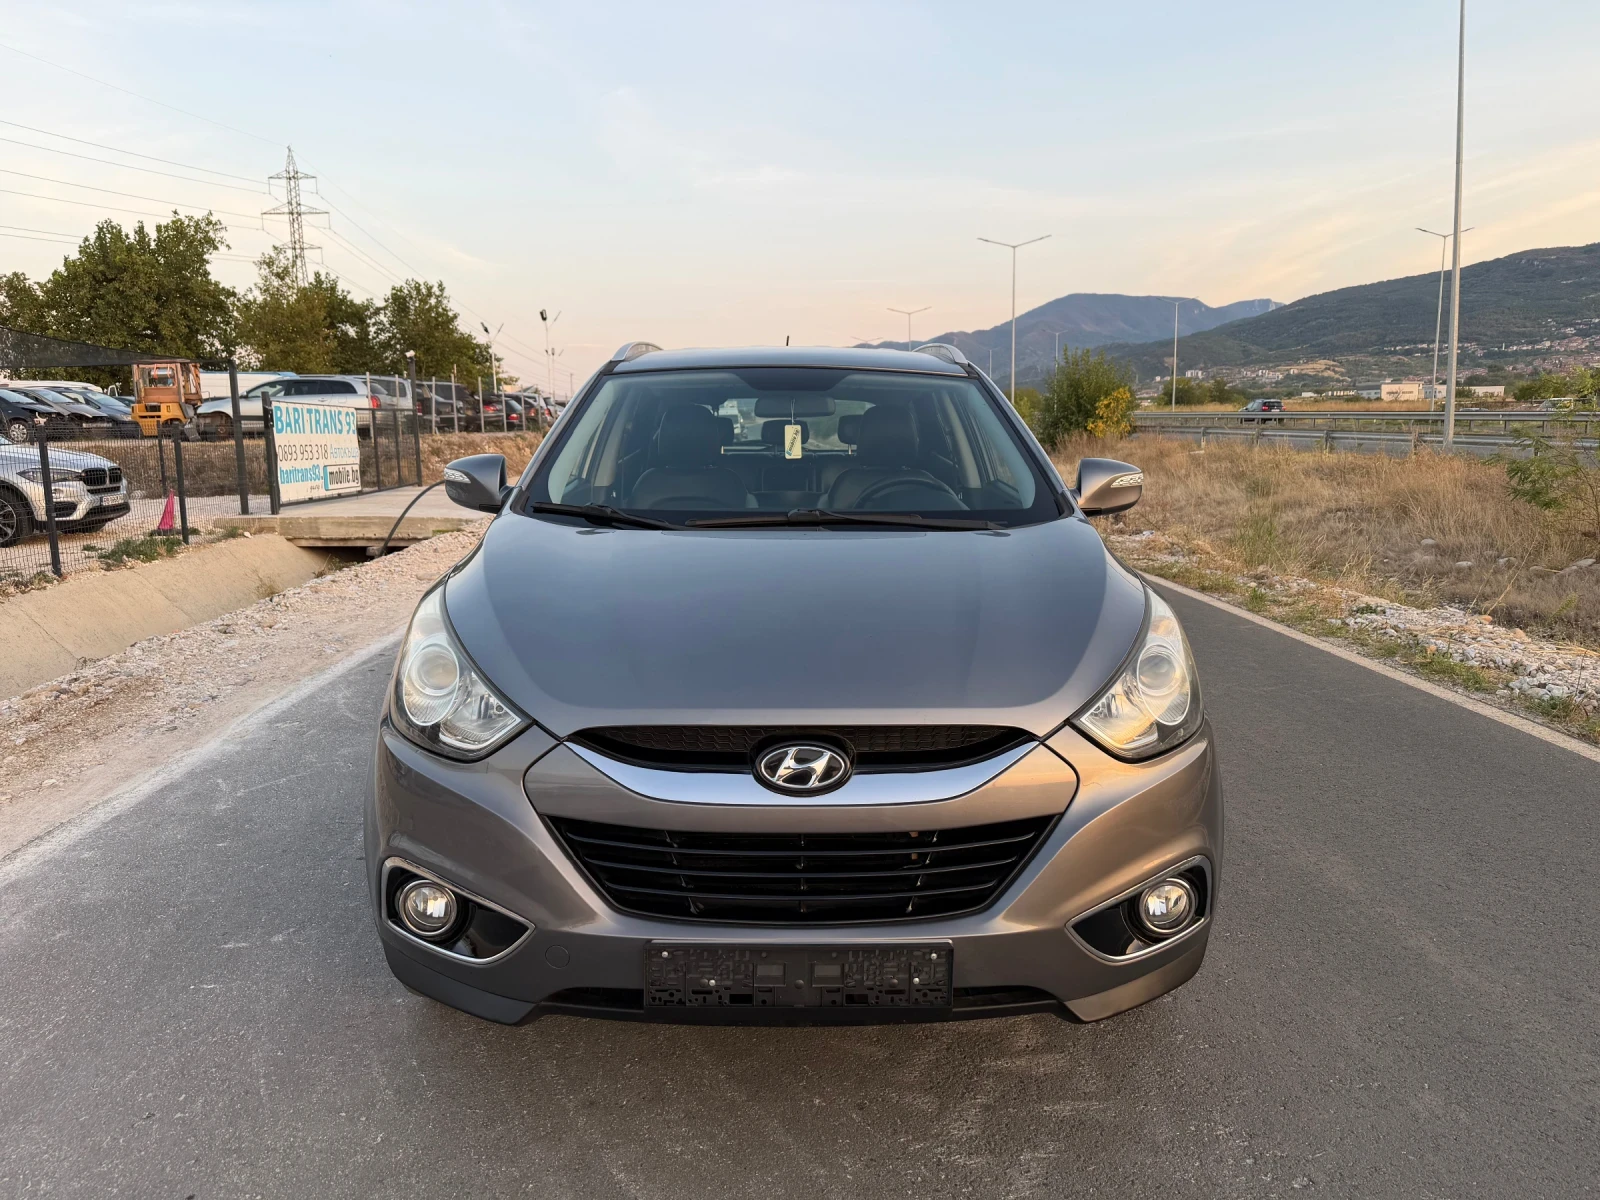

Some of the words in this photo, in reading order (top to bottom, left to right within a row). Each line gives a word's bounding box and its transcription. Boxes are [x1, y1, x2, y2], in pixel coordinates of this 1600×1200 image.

[274, 406, 305, 434] BARI
[306, 408, 344, 435] TRANS
[344, 411, 356, 435] 93
[278, 445, 298, 461] 0893
[300, 444, 314, 460] 953
[315, 444, 329, 460] 318
[329, 466, 360, 485] mobile.bg
